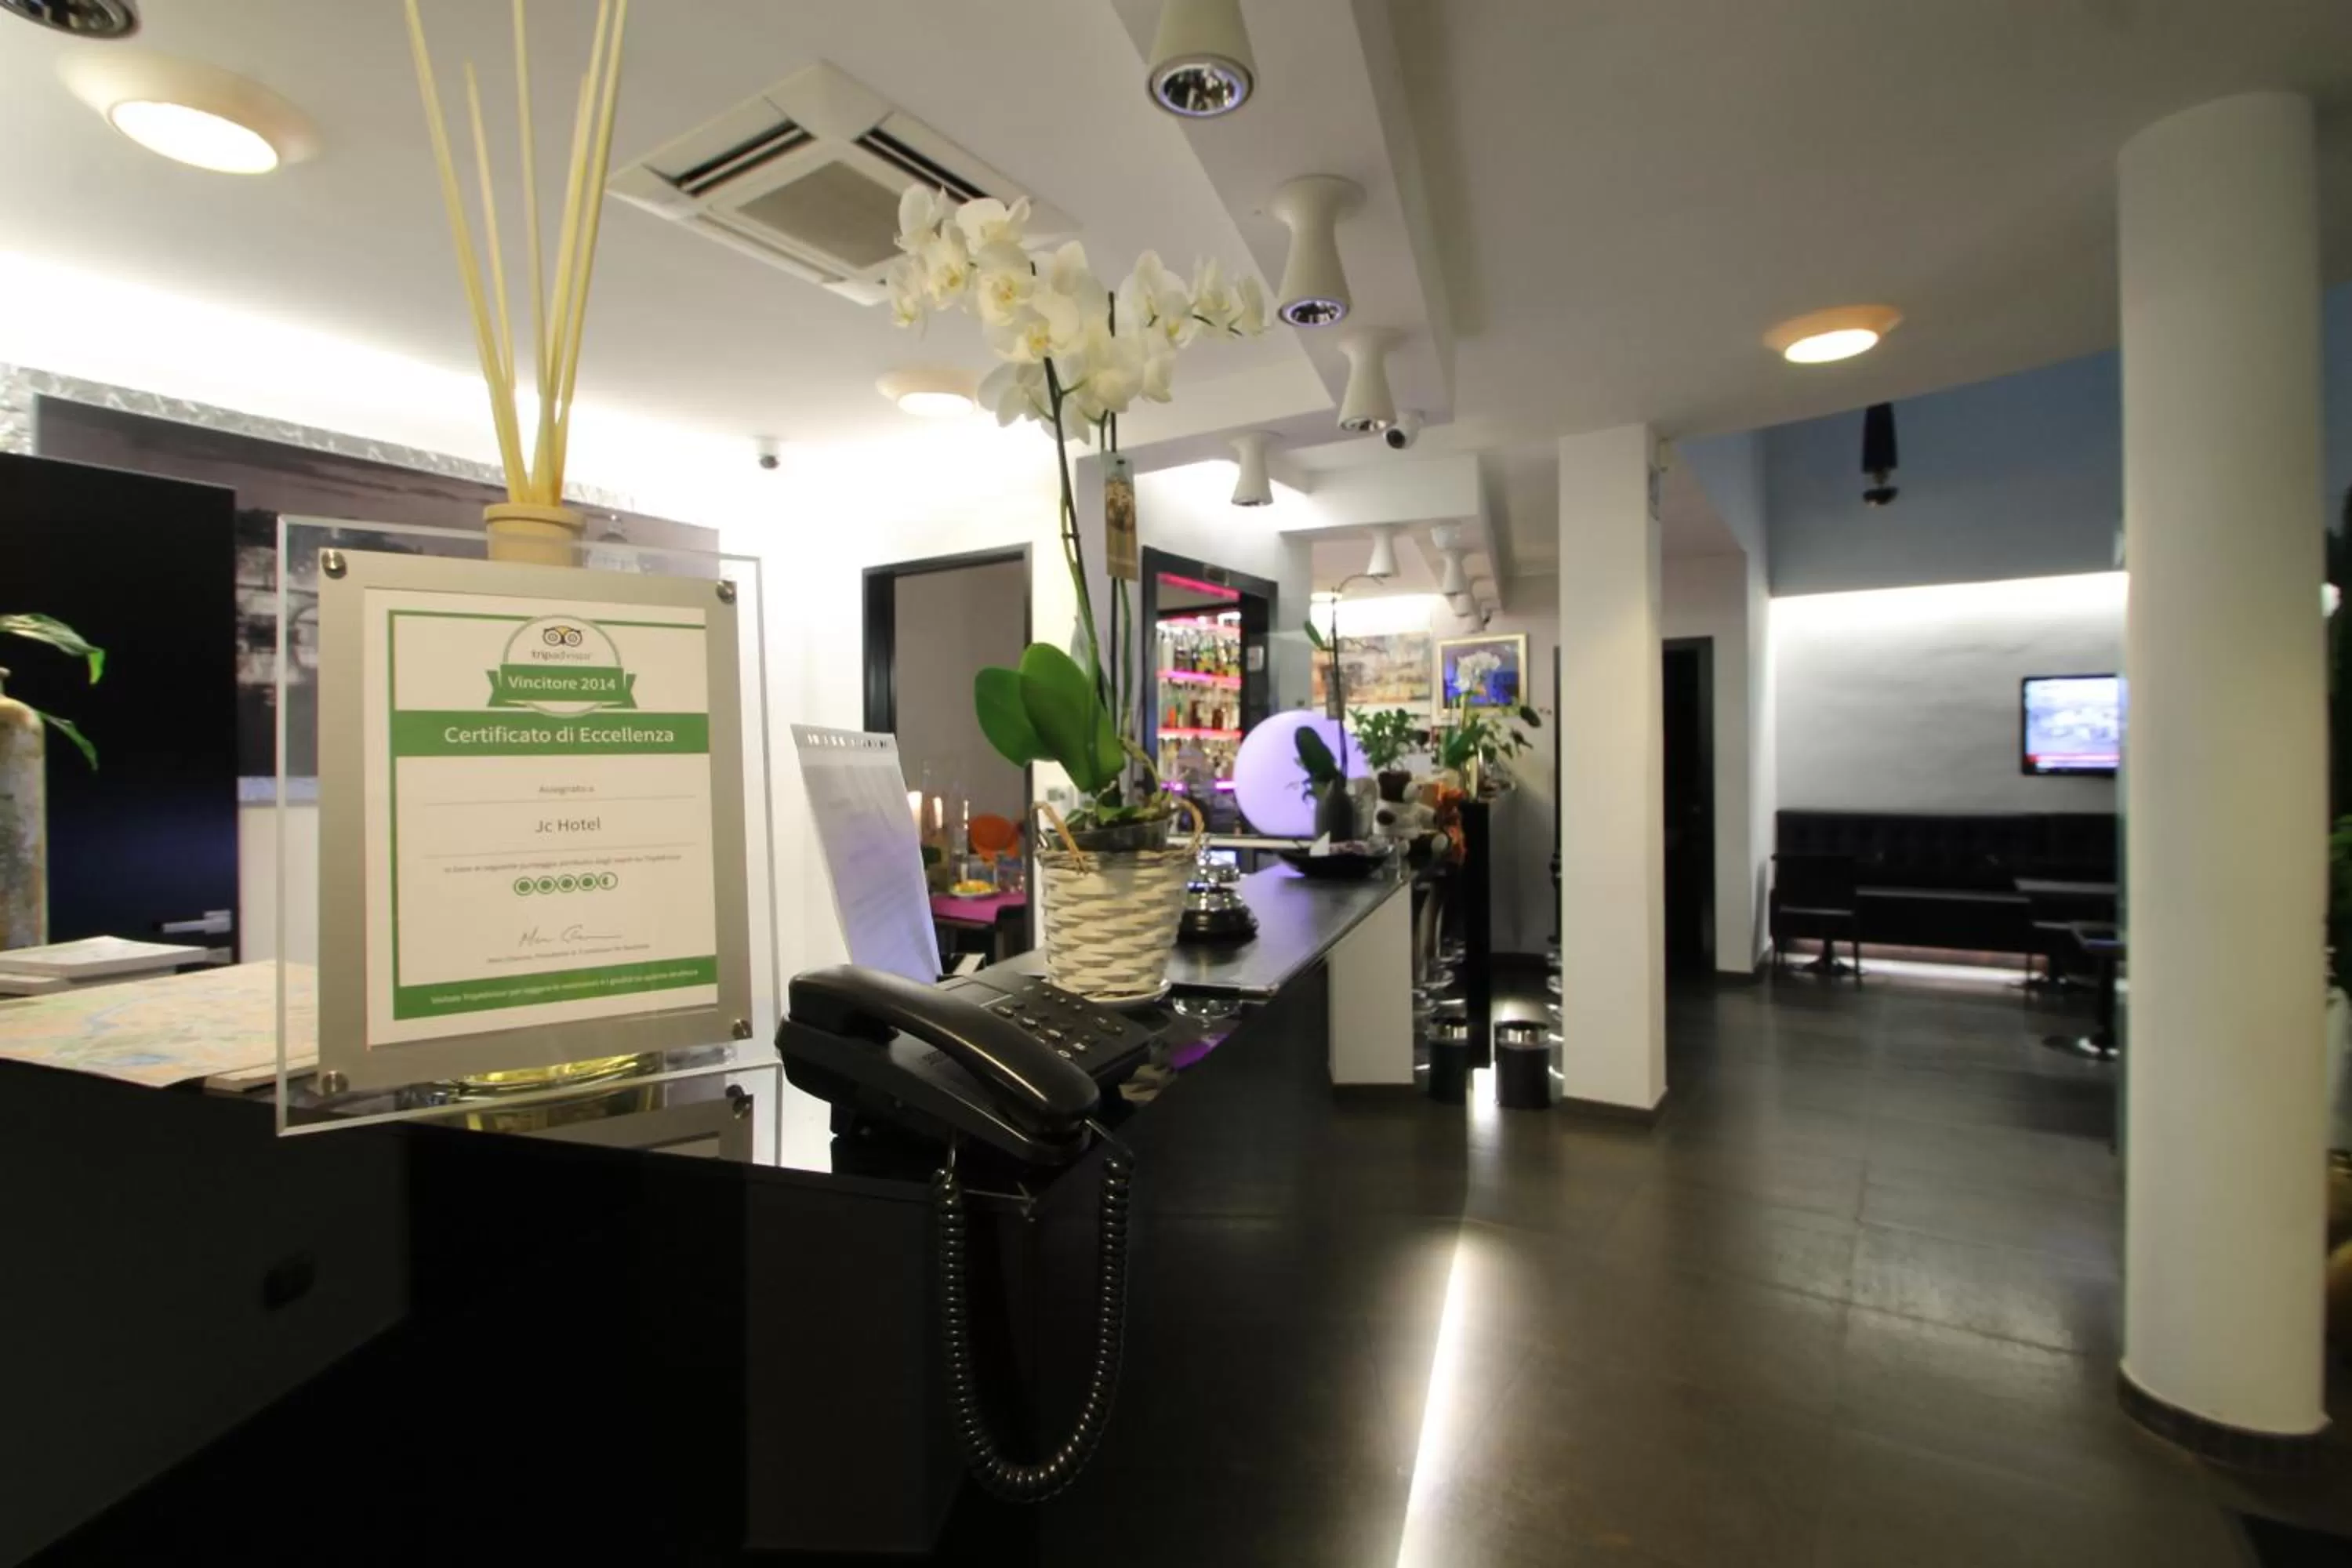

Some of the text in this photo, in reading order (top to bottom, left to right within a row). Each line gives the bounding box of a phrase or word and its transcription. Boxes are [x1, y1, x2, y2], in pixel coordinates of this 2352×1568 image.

[507, 674, 616, 691] Vincitore 2014
[444, 726, 675, 743] Certificato di Eccellenza
[535, 815, 601, 833] Jc Hotel
